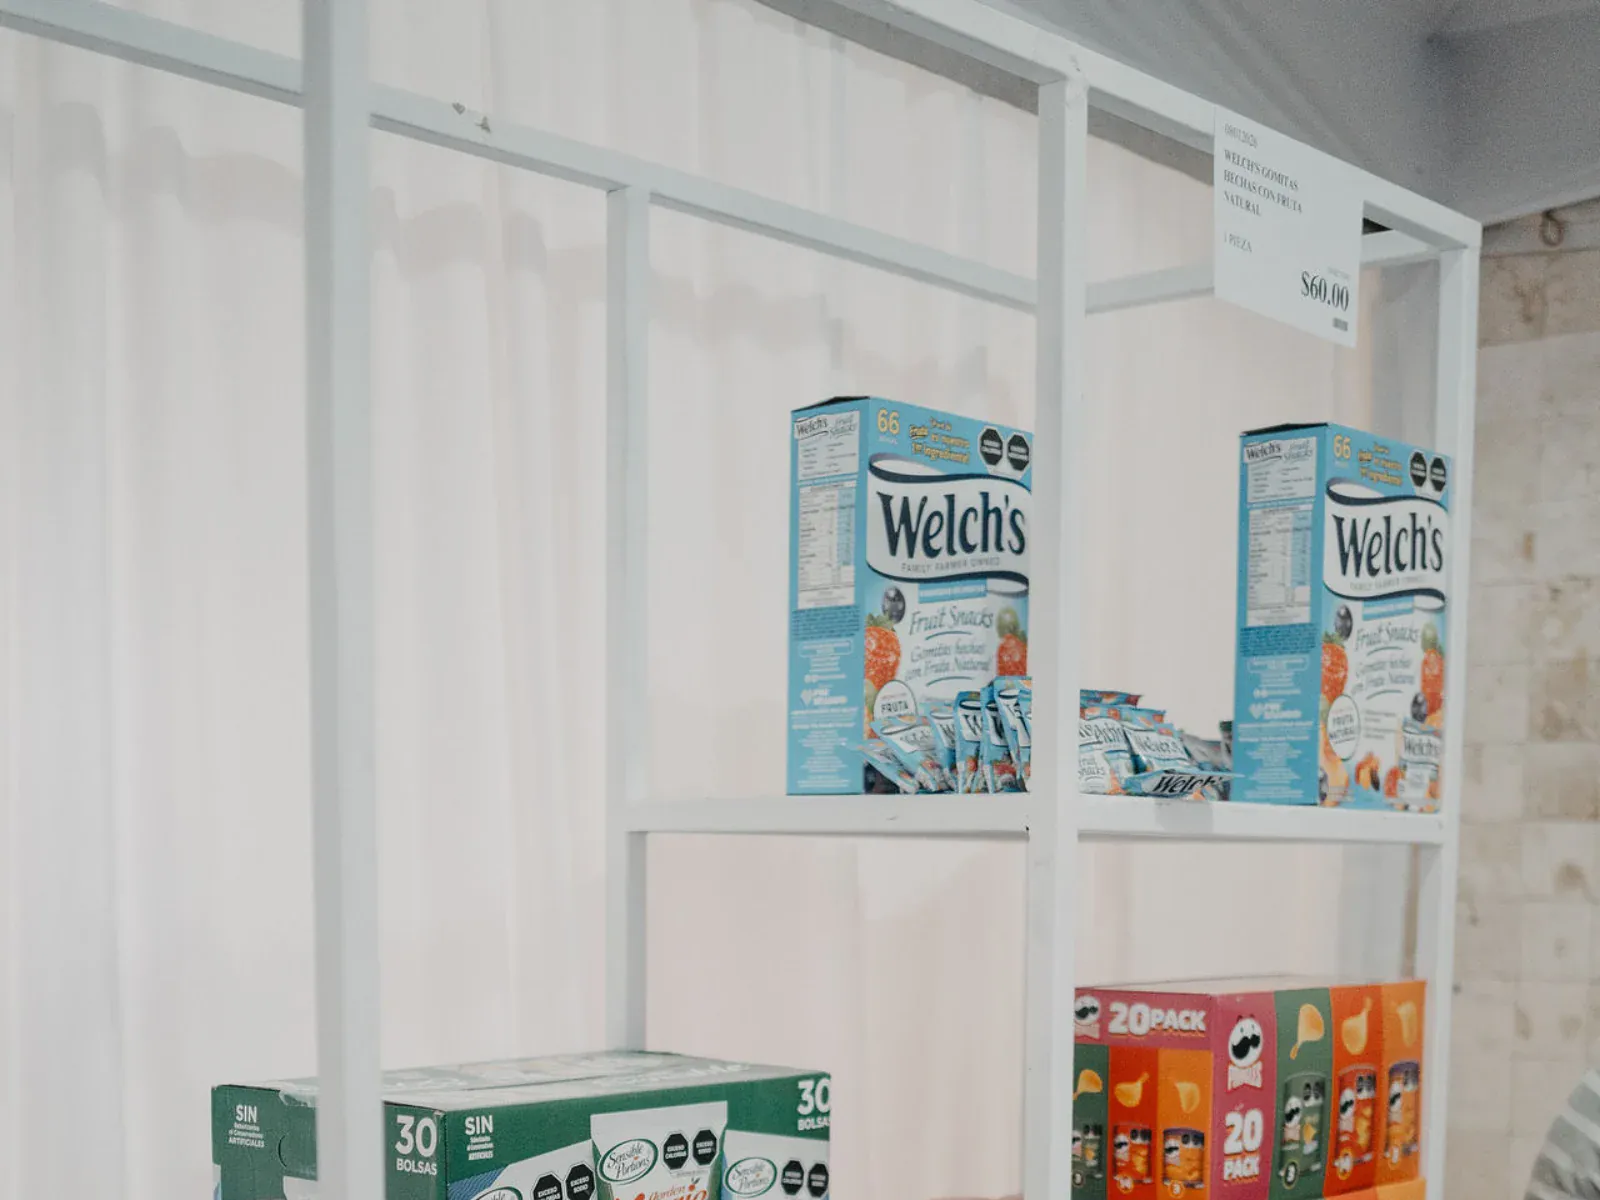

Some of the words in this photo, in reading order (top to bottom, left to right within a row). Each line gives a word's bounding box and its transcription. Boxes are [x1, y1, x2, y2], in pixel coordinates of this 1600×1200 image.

[1224, 169, 1257, 193] HECHAS
[1258, 186, 1275, 201] CON
[1277, 193, 1302, 213] FRUTA
[1224, 190, 1261, 217] NATURAL
[1301, 270, 1349, 311] $60.00
[877, 409, 900, 435] 66
[1333, 434, 1351, 459] 66
[876, 491, 1026, 559] Welch's
[1332, 512, 1443, 577] Welch's
[909, 607, 947, 636] Fruit
[949, 605, 994, 629] Snacks
[880, 700, 909, 714] FRUTA
[1108, 1001, 1150, 1037] 20
[1150, 1008, 1206, 1035] PACK
[797, 1078, 831, 1116] 30
[235, 1104, 258, 1123] SIN
[465, 1115, 494, 1136] SIN
[228, 1137, 265, 1148] ARTIFICIALES
[395, 1114, 438, 1158] 30
[1223, 1108, 1264, 1156] 20
[396, 1157, 438, 1176] BOLSAS
[607, 1141, 645, 1169] Sensible
[614, 1156, 650, 1178] Portions
[1223, 1155, 1260, 1181] PACK
